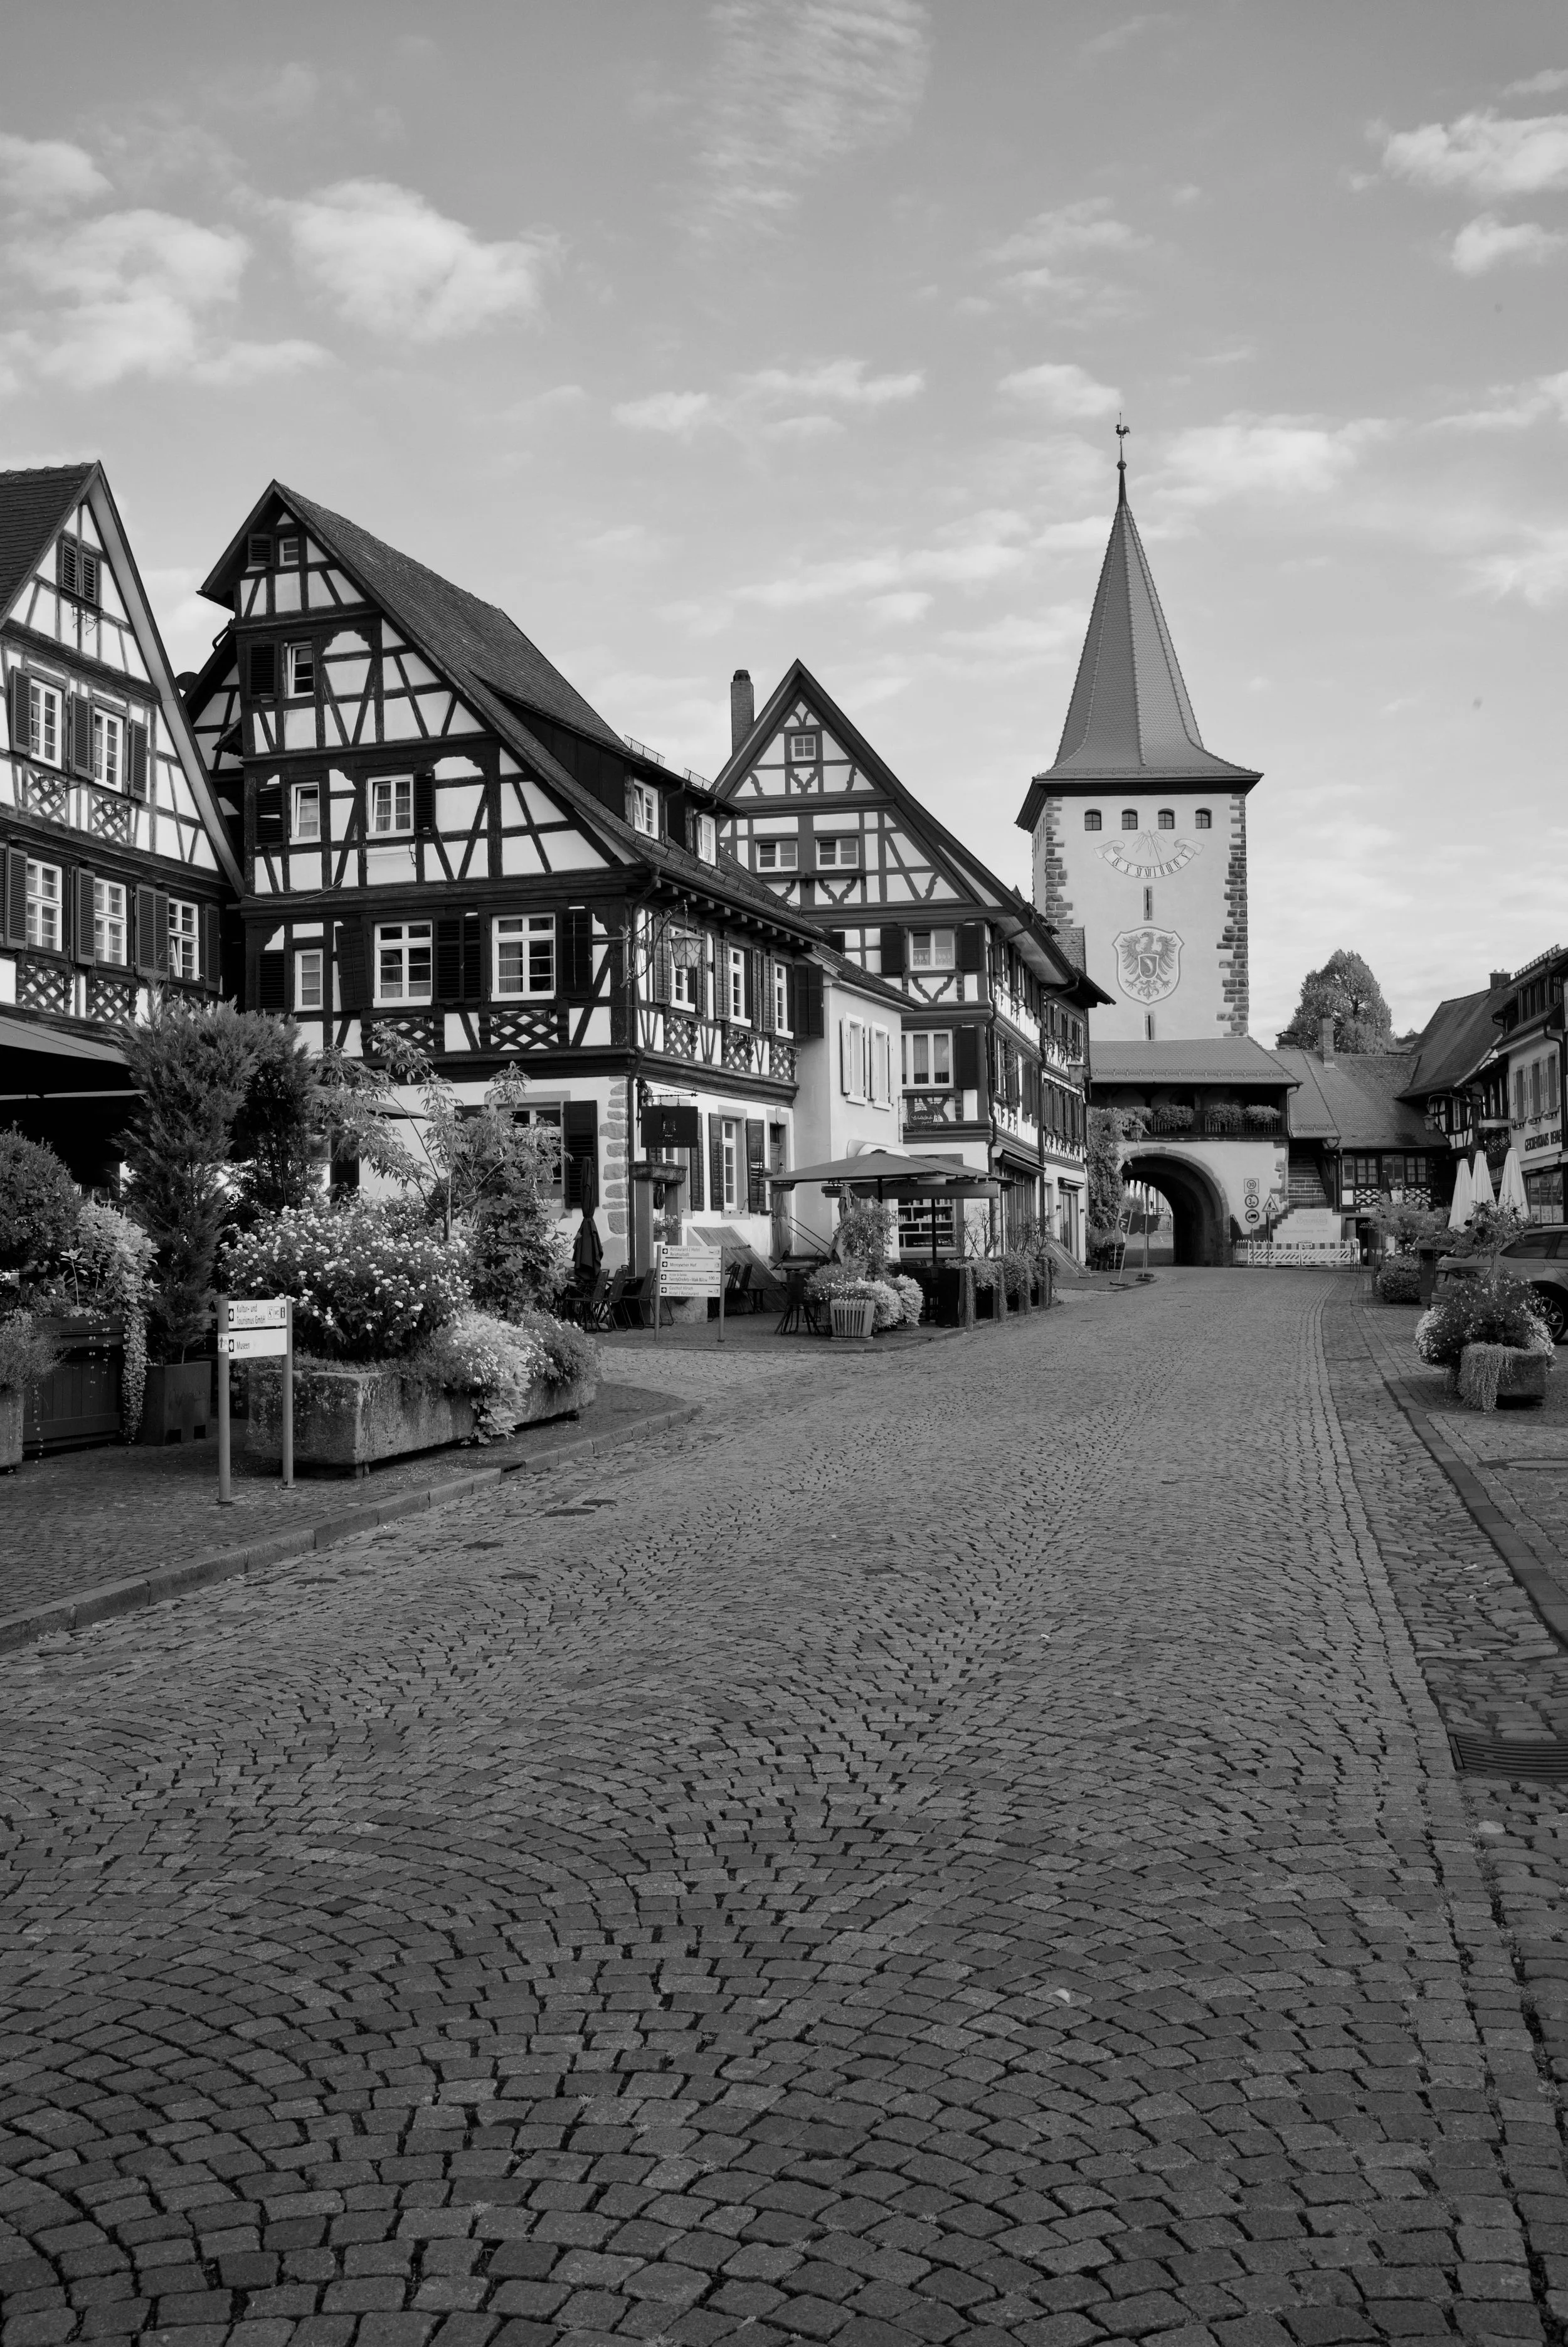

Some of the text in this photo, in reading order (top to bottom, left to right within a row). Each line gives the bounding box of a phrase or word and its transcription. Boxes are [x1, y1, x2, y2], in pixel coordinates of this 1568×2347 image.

[236, 1304, 250, 1313] Kultur-
[236, 1315, 266, 1325] Tourismus GmbH
[236, 1341, 250, 1350] Museen
